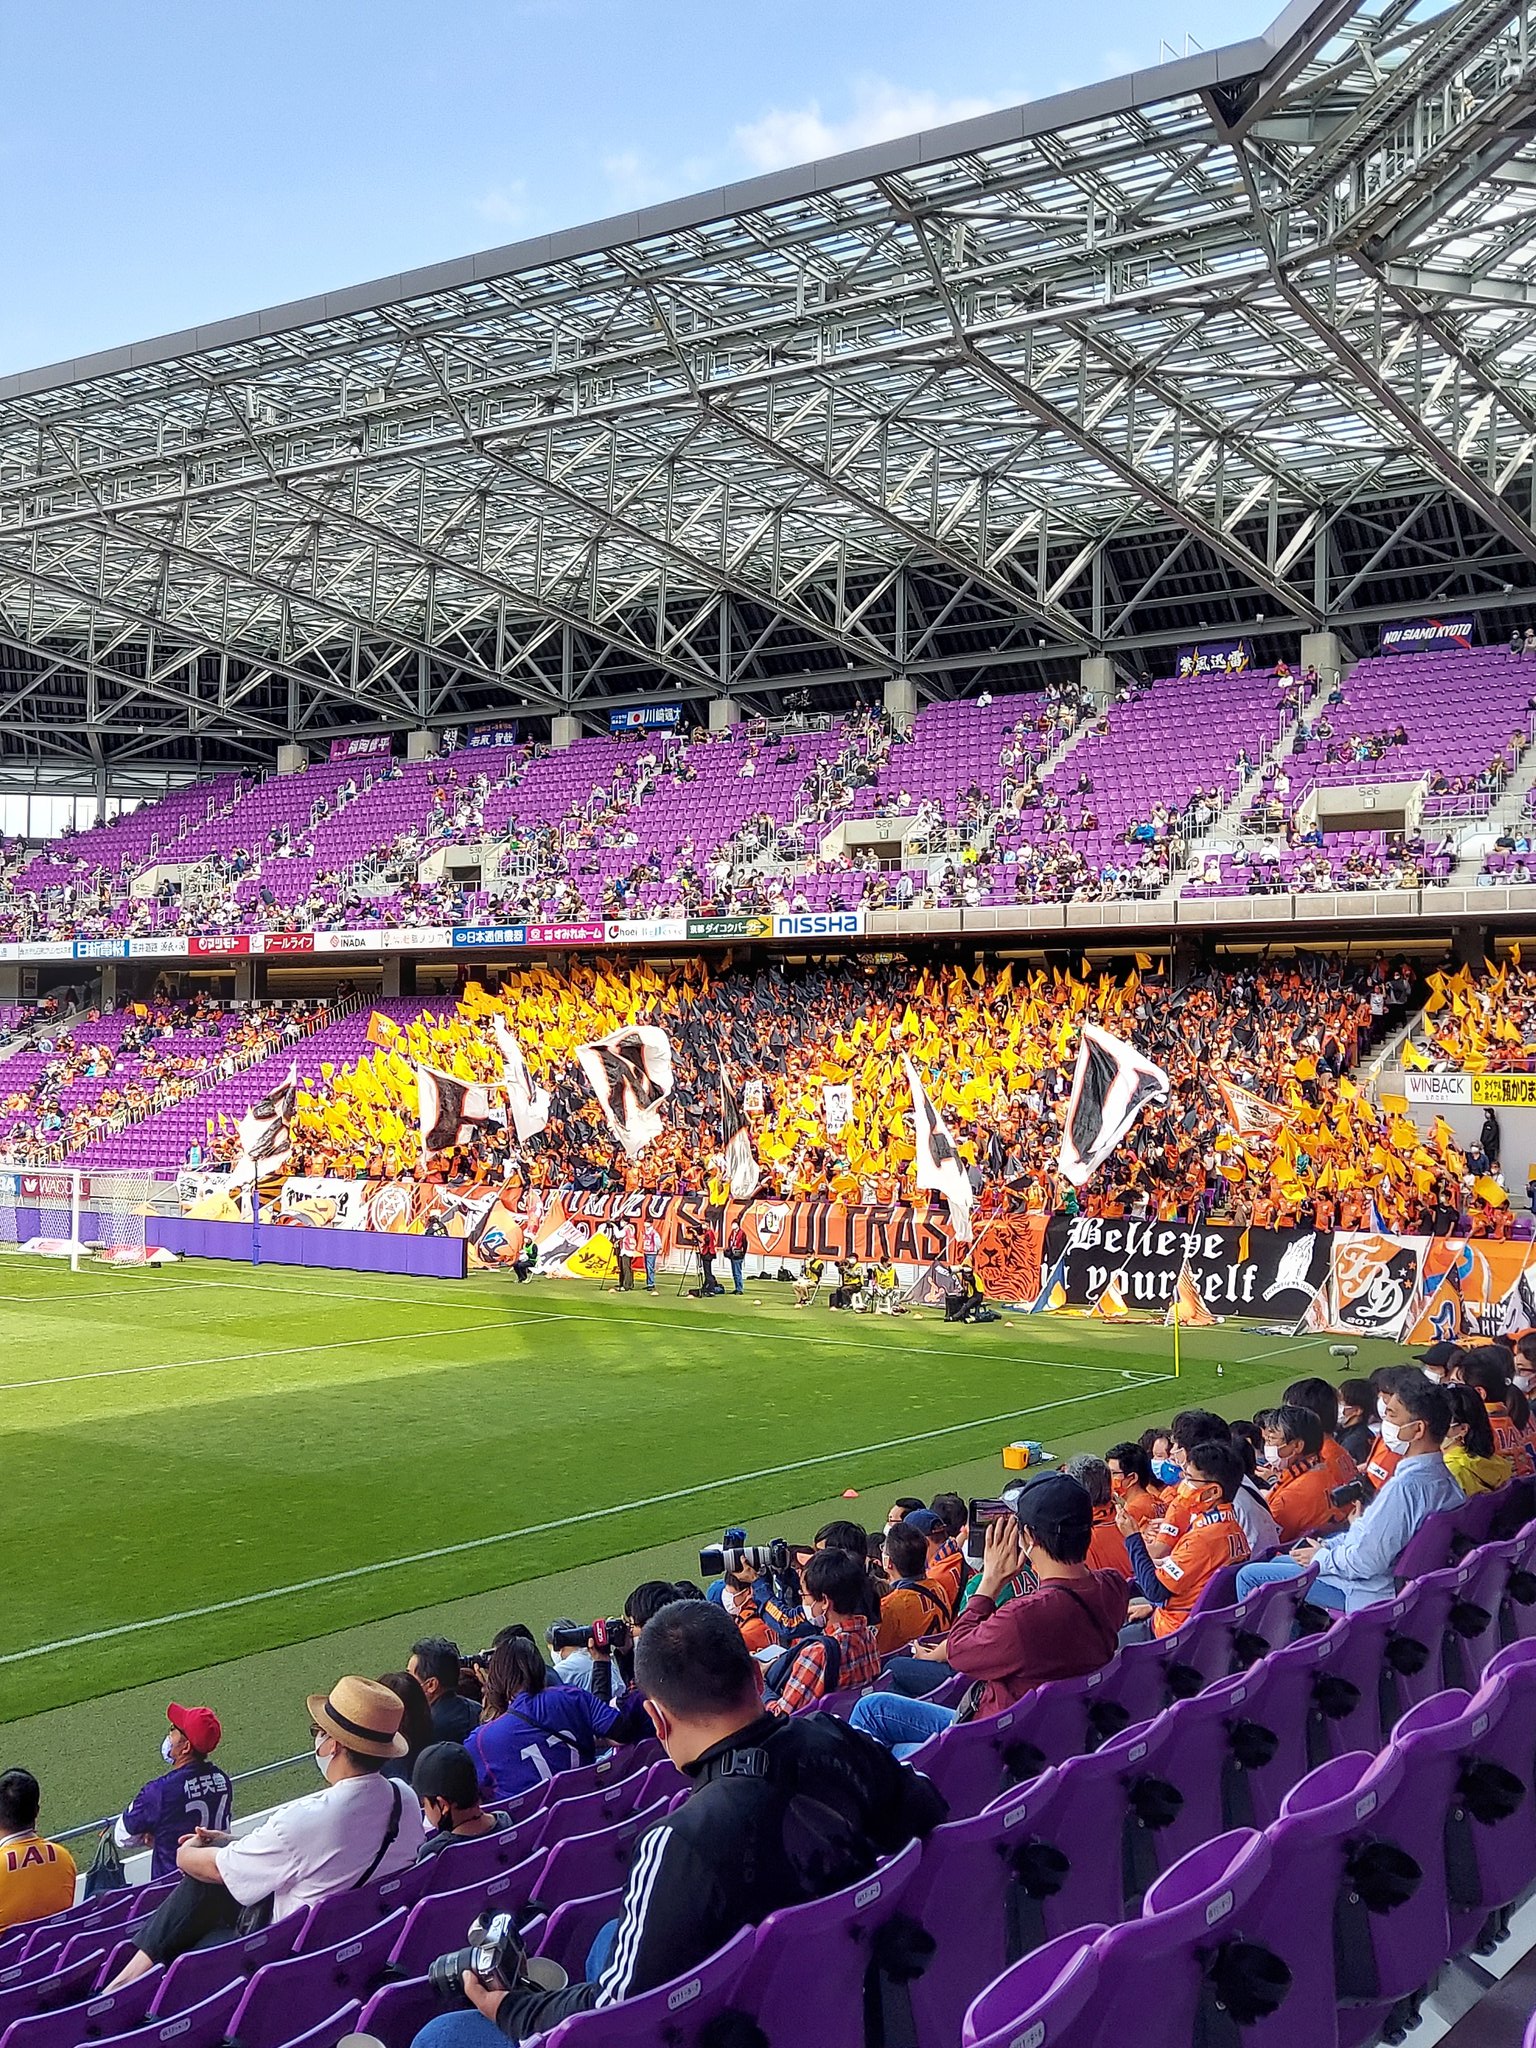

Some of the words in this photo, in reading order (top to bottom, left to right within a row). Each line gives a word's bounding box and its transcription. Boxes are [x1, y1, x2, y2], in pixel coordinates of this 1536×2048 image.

[1384, 630, 1401, 644] NOI
[1403, 627, 1437, 641] SIAMO
[1437, 623, 1472, 638] KYOTO
[1358, 786, 1380, 797] S26
[265, 936, 313, 950] アールライフ
[341, 938, 366, 948] INADA
[1410, 1077, 1465, 1094] WINBACK
[40, 1178, 89, 1195] WACOL
[1066, 1216, 1226, 1260] Believe
[183, 1772, 228, 1799] 任天堂
[4, 1842, 58, 1873] IAI
